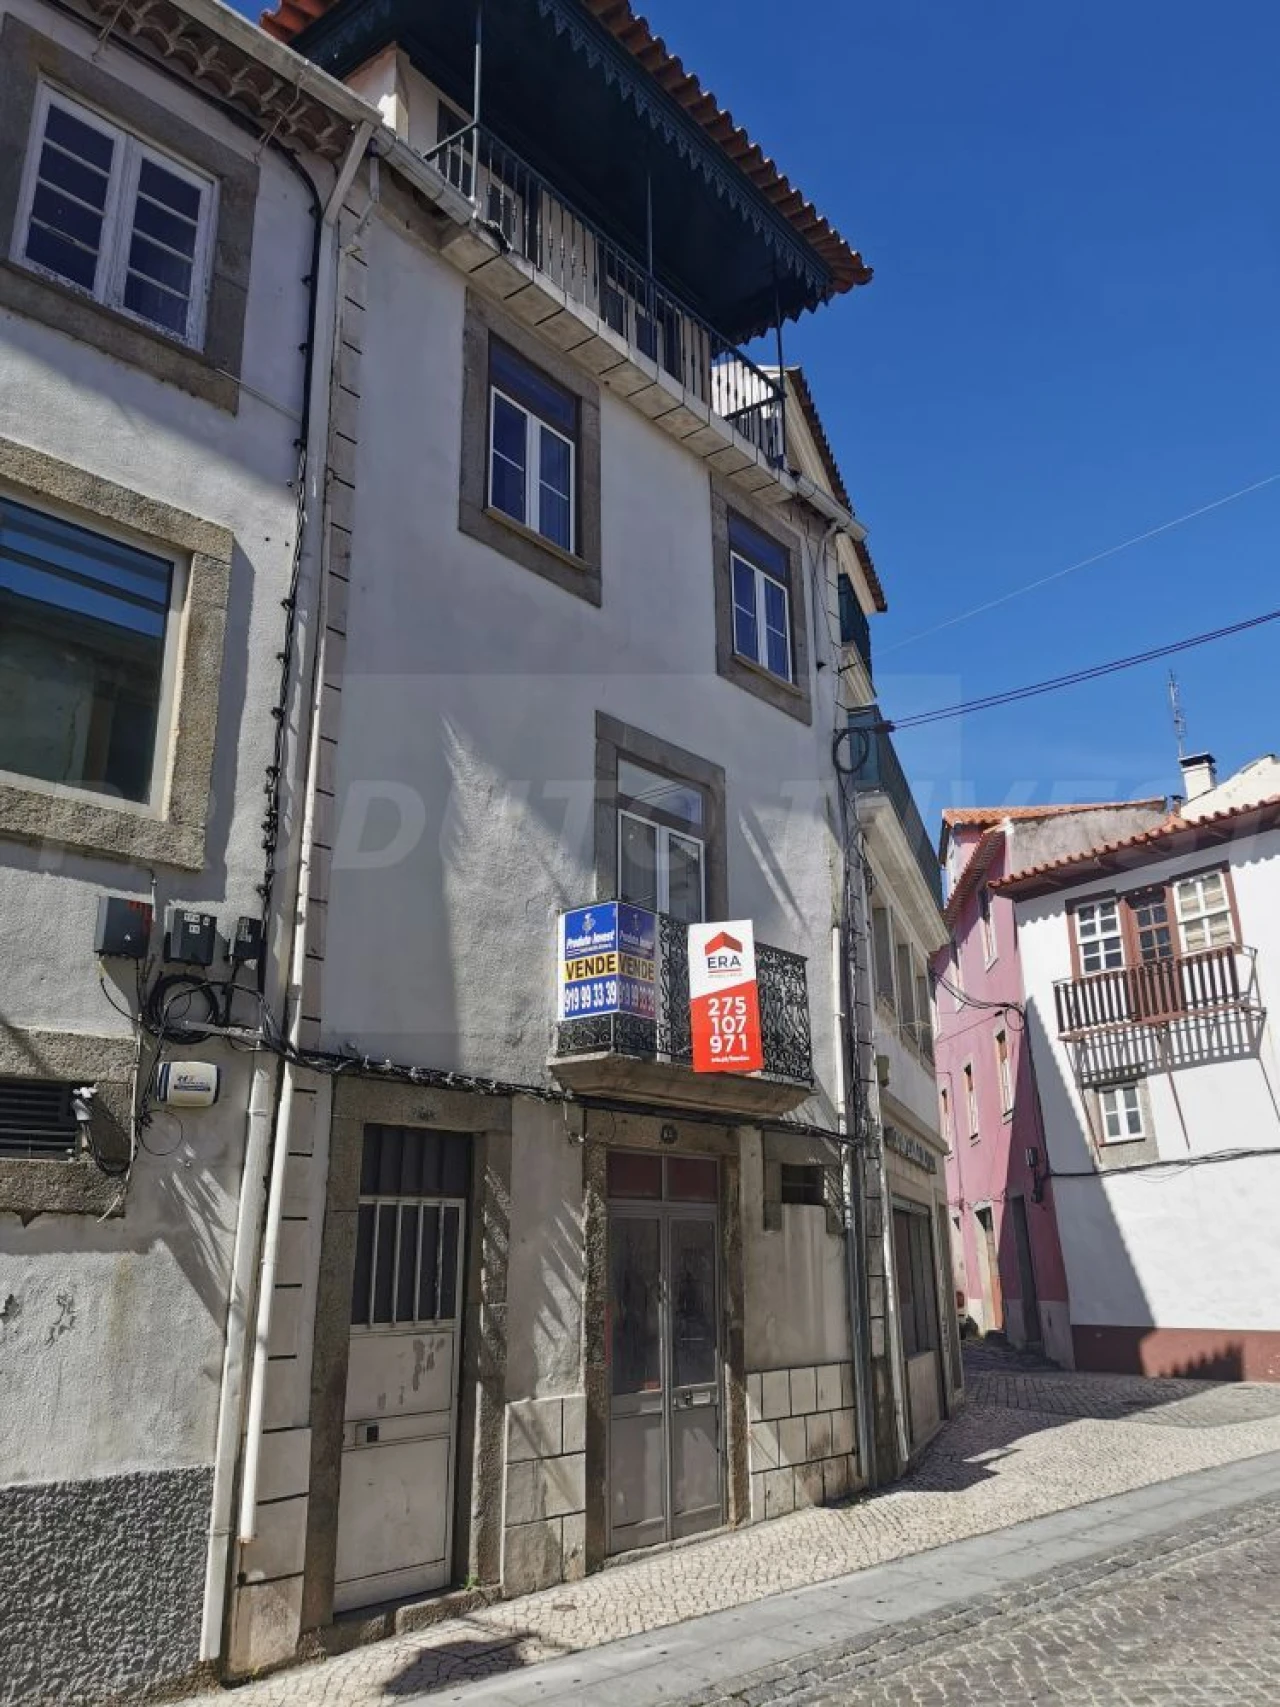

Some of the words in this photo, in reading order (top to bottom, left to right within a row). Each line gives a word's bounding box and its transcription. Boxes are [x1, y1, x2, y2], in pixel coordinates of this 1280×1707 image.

[565, 954, 616, 980] VENDE
[620, 954, 655, 981] VENDE
[708, 956, 741, 968] ERA
[708, 996, 747, 1016] 275
[711, 1015, 747, 1034] 107
[709, 1034, 747, 1053] 971
